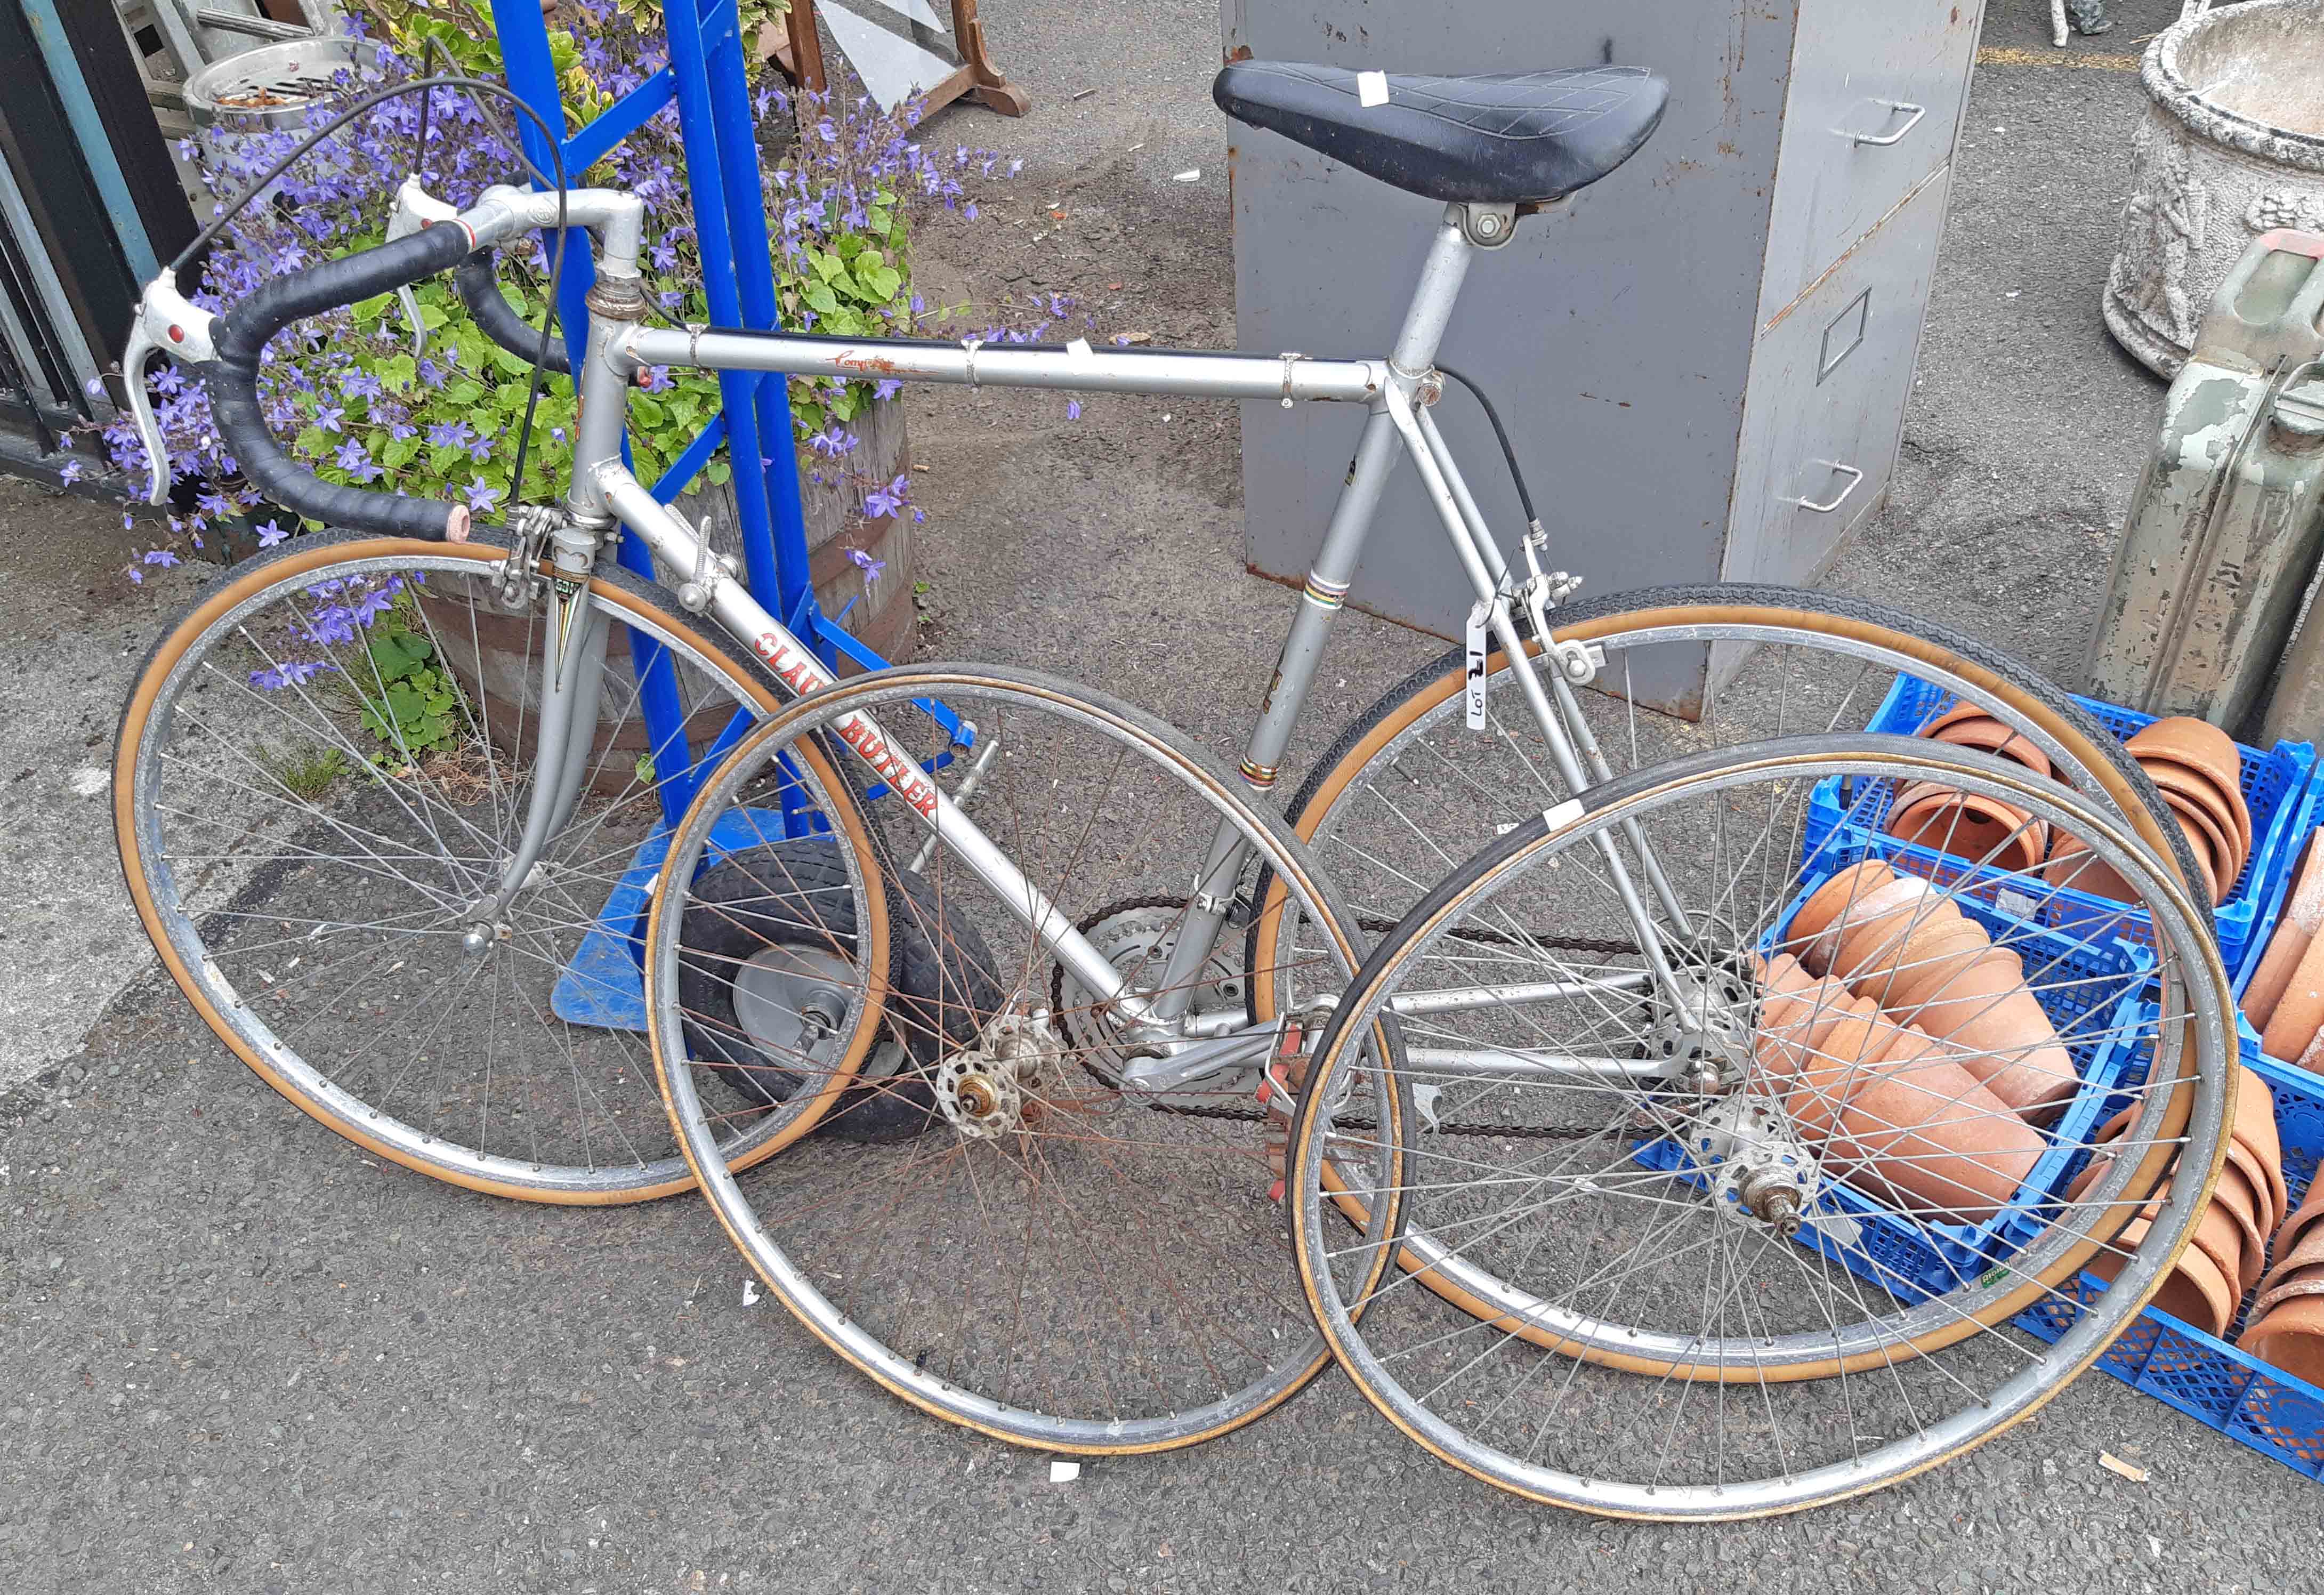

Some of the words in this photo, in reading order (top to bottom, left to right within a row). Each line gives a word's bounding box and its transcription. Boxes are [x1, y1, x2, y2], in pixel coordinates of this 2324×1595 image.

[755, 632, 828, 696] CLAU
[840, 717, 938, 818] BUTLER
[1471, 689, 1482, 716] LOT
